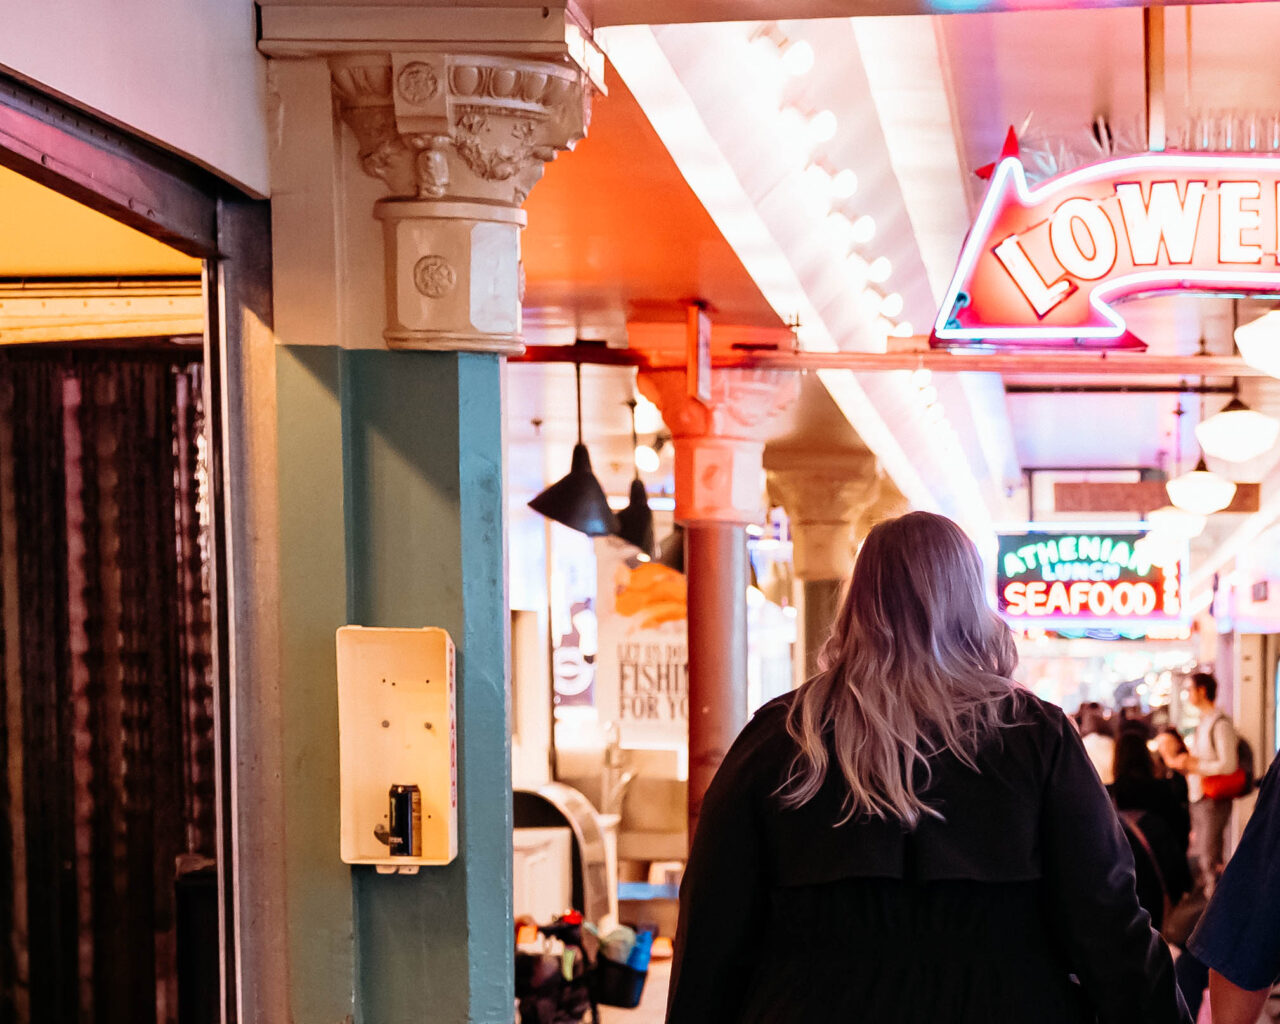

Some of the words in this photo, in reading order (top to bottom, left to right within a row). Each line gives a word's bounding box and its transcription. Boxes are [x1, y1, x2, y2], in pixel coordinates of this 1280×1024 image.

[1041, 561, 1121, 581] LUNCH
[1003, 581, 1157, 616] SEAFOOD
[619, 697, 659, 720] FOR
